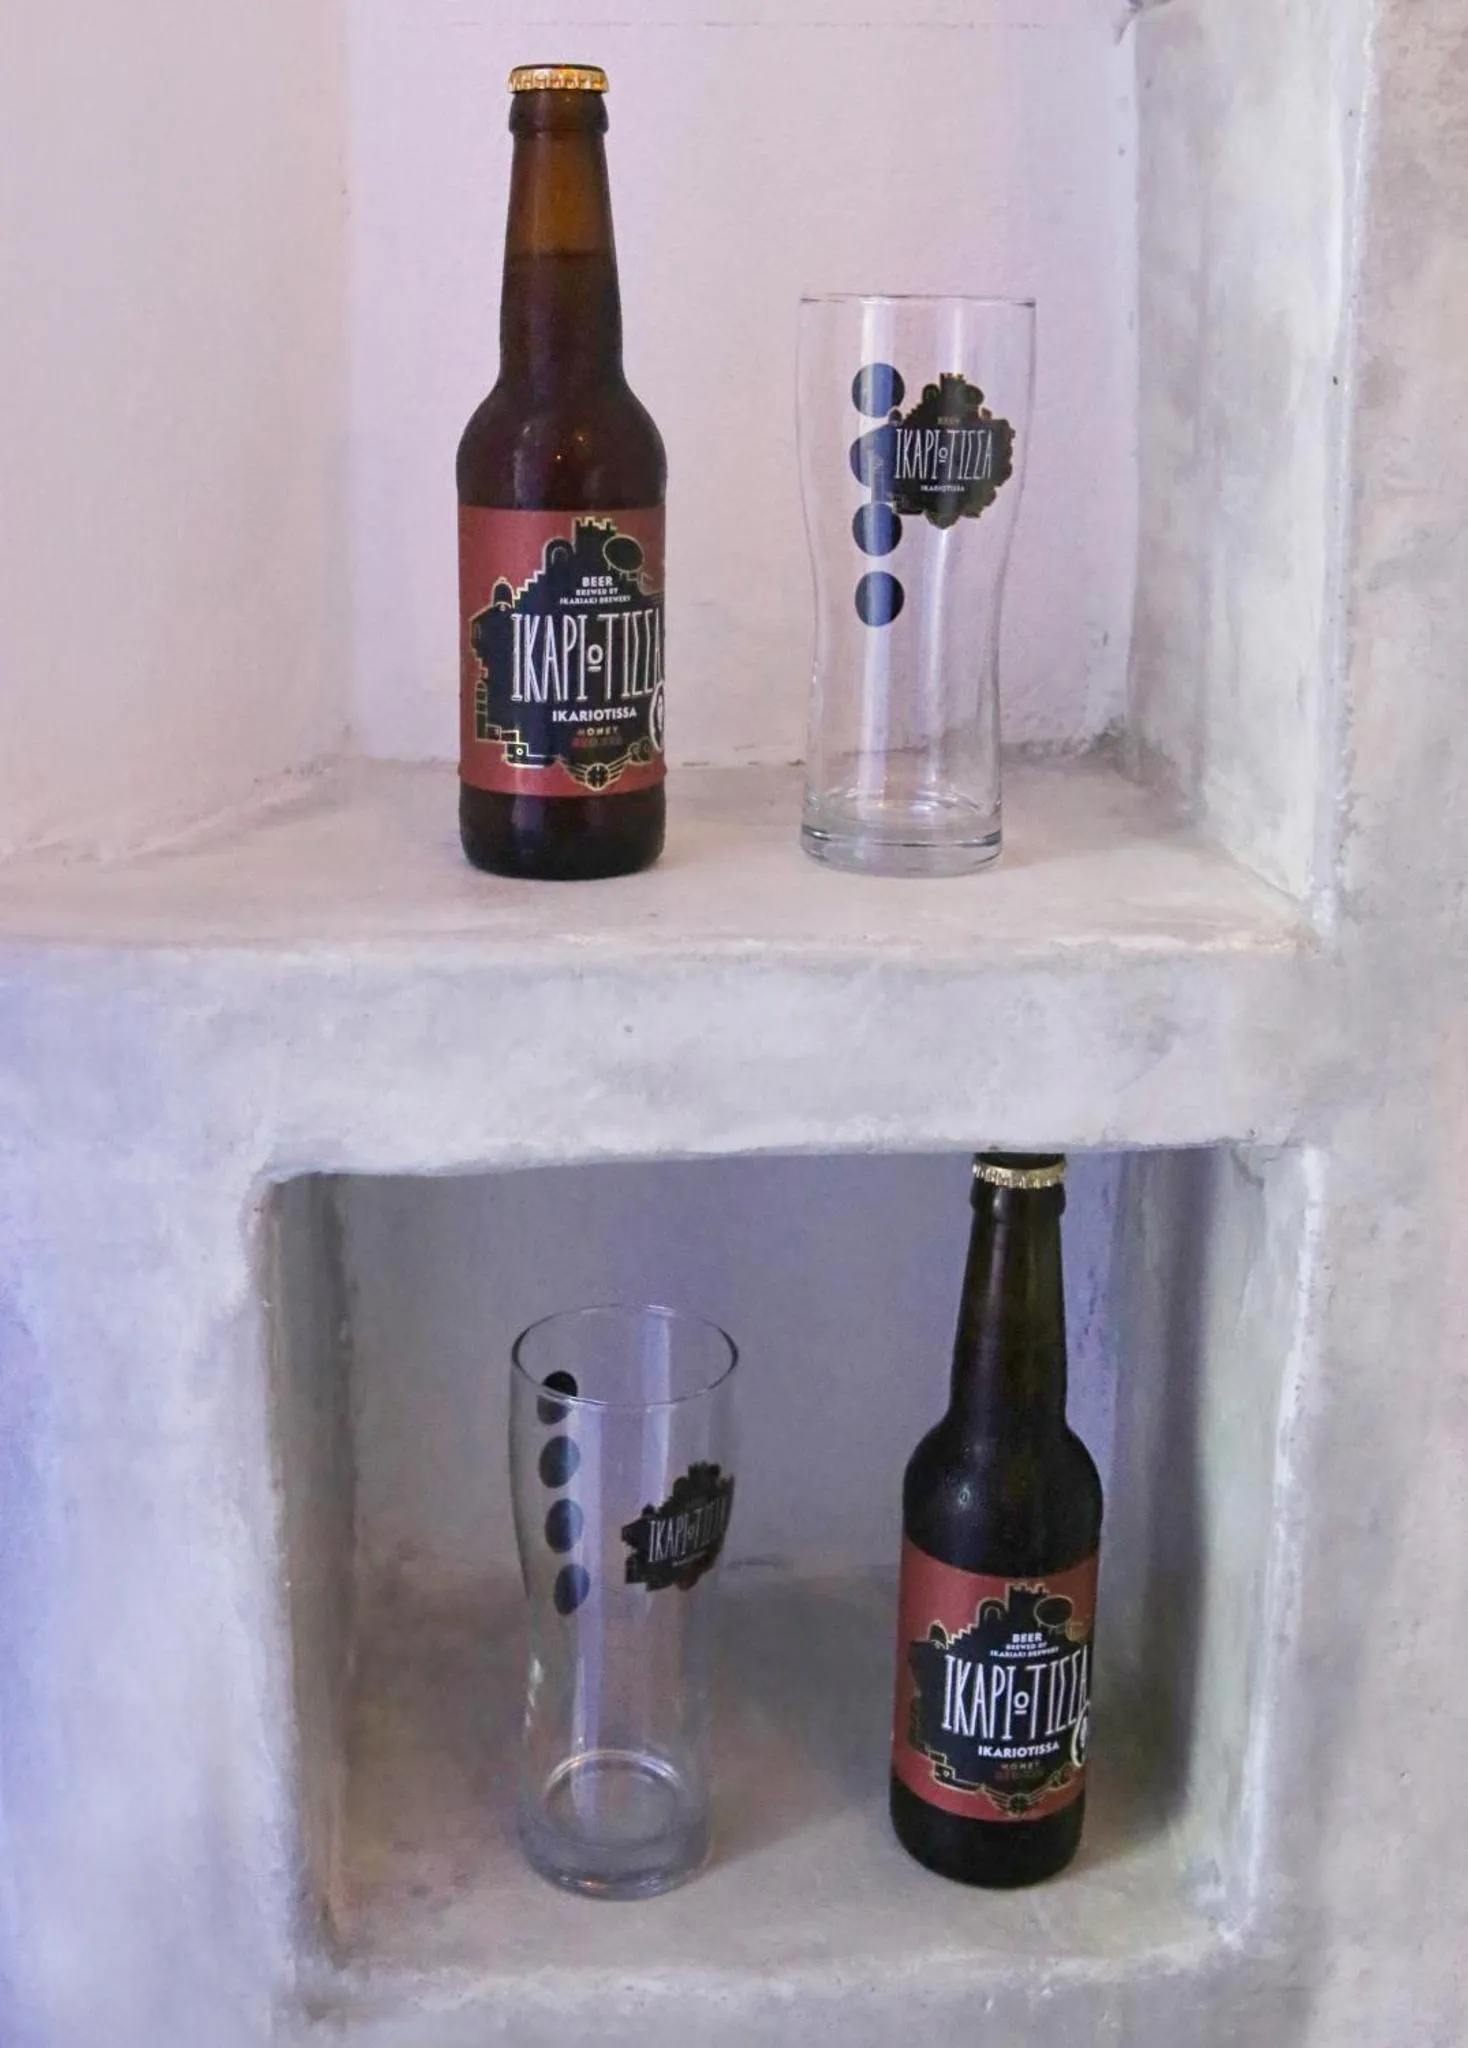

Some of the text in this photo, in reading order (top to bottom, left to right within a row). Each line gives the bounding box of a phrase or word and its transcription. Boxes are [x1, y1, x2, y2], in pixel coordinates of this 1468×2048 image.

[582, 576, 613, 587] BEER
[576, 587, 618, 596] BREWED BY
[552, 706, 637, 722] IKARIOTISSA
[1012, 1632, 1042, 1643] BEER
[1005, 1643, 1036, 1651] BREWED
[978, 1741, 1060, 1759] IKARIOTISSA
